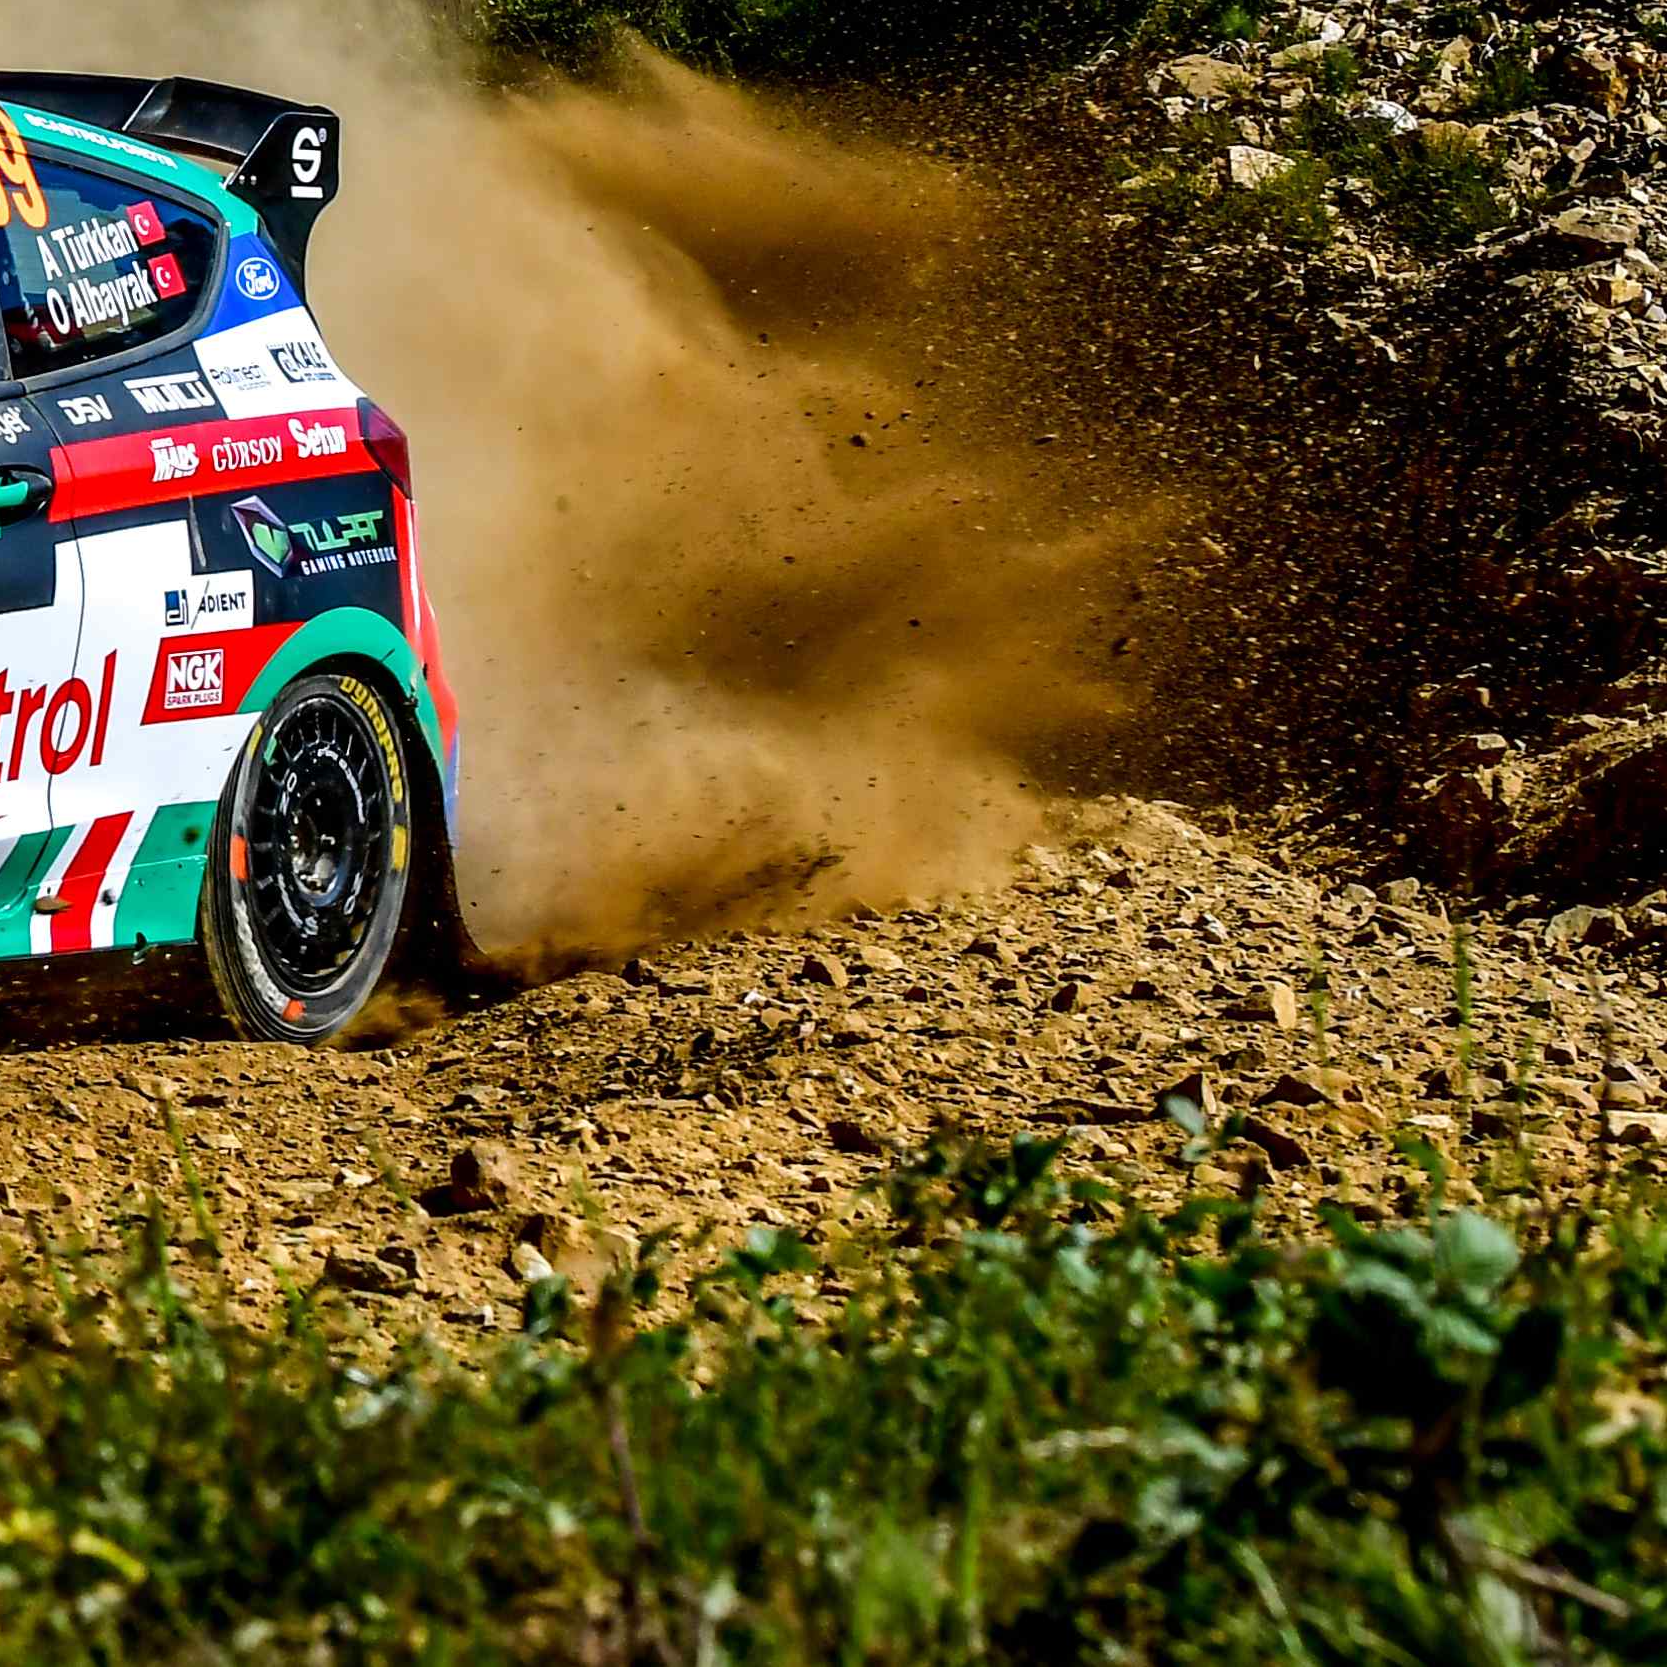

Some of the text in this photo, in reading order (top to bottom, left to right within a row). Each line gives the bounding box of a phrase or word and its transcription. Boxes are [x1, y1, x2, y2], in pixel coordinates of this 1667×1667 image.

[36, 218, 139, 281] A Türkkan
[46, 261, 158, 335] O Albayrak
[57, 394, 113, 426] DSV
[212, 436, 283, 472] GÜRSOY
[287, 418, 348, 460] Setur
[300, 545, 398, 577] GAMING NOTEBOOK
[198, 591, 247, 615] ADIENT
[170, 652, 223, 693] NGK
[167, 690, 221, 708] SPARK PLUGS
